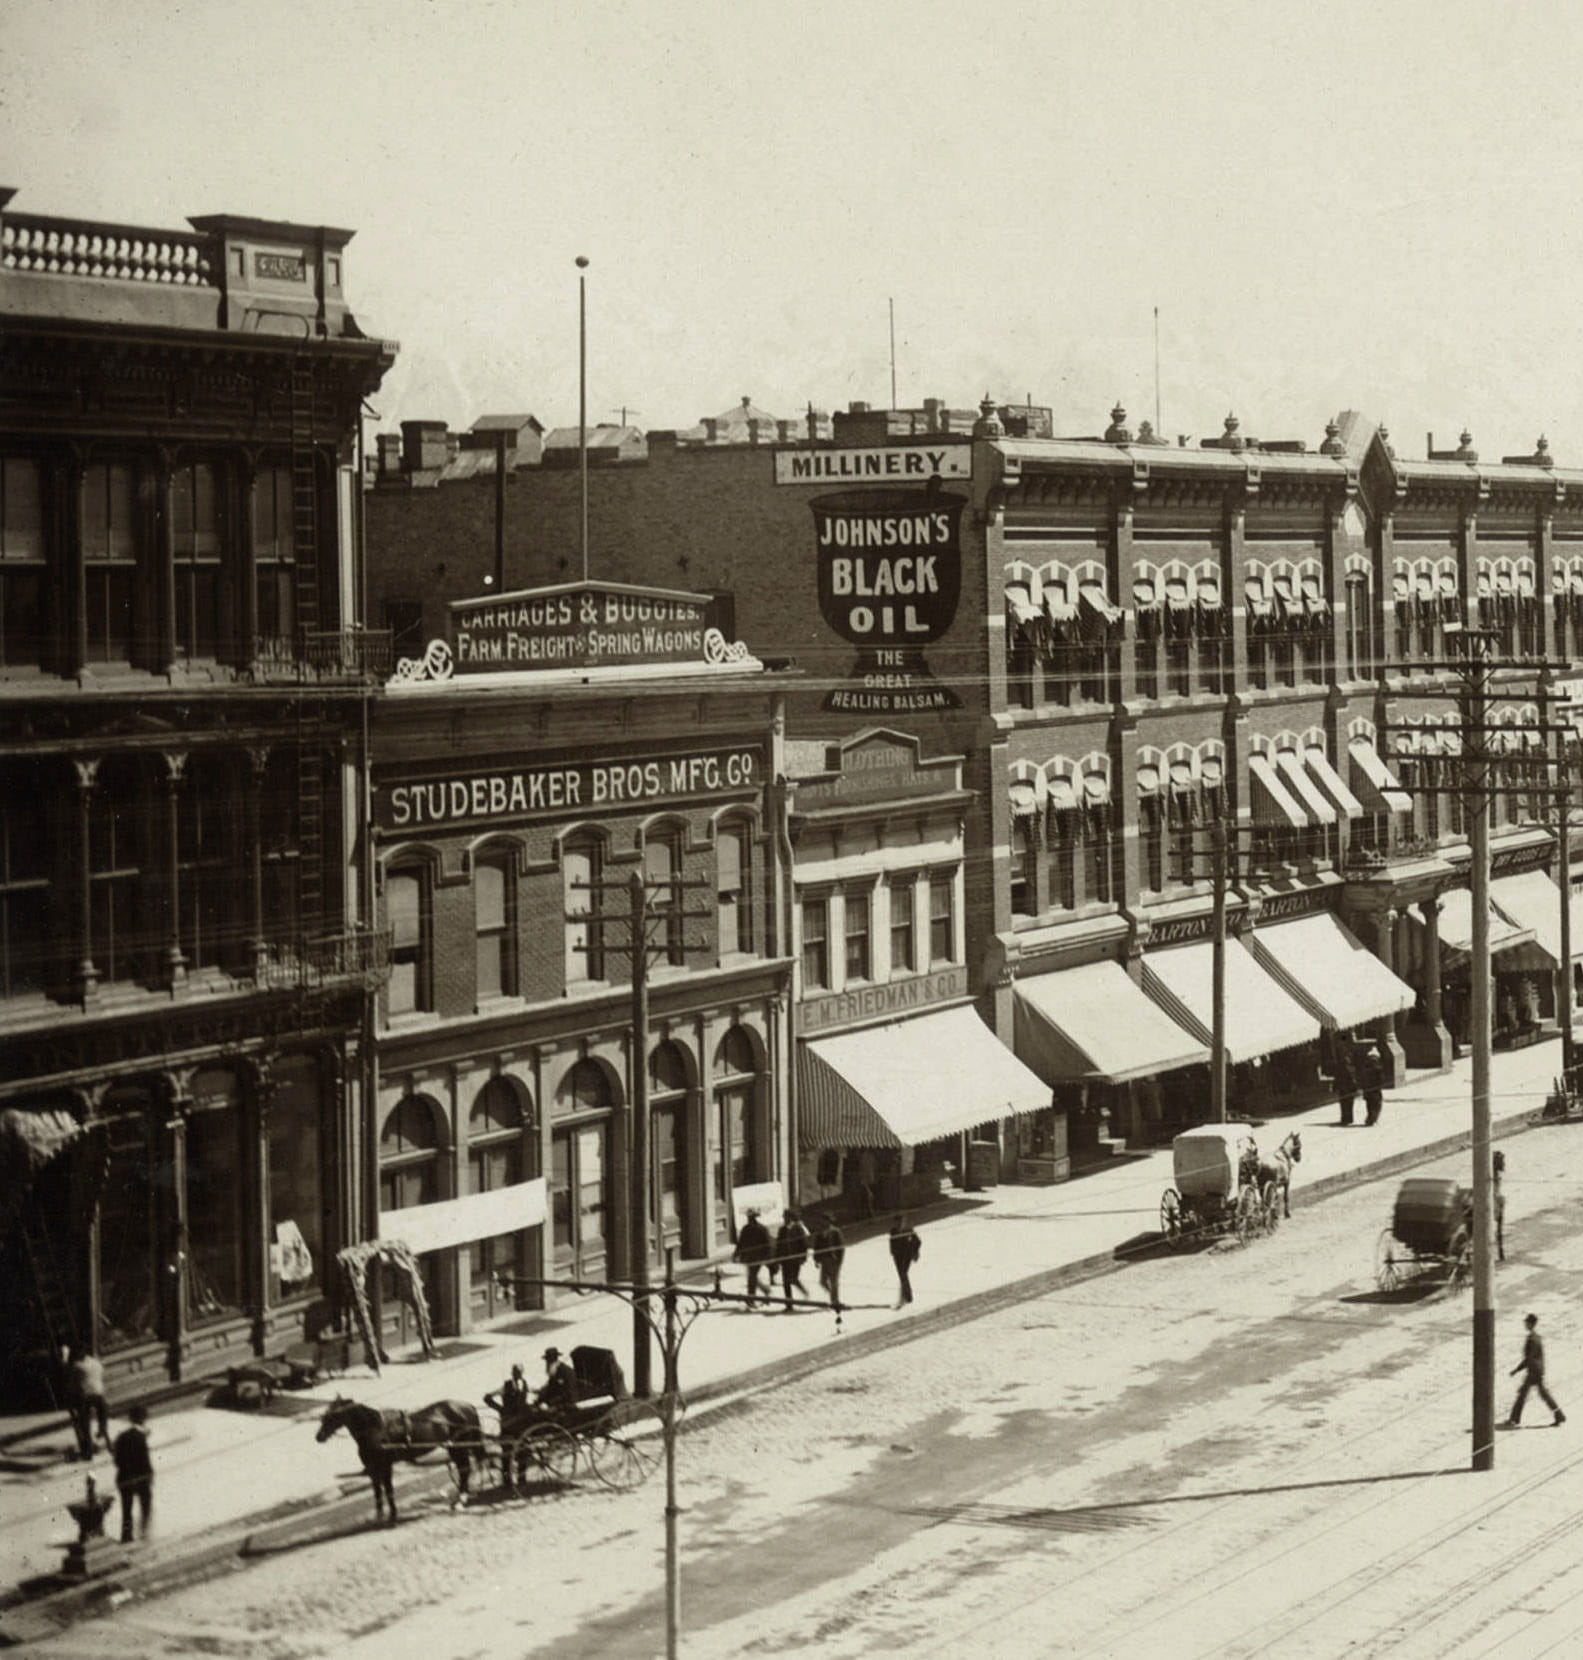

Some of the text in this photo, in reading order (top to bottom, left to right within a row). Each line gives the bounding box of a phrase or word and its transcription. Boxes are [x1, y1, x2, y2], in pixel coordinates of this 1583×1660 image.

[792, 452, 958, 477] MILLINERY.
[820, 513, 949, 546] JOHNSON'S
[832, 556, 939, 596] BLACK
[462, 598, 571, 628] CARRIAGES
[580, 594, 597, 624] &
[849, 605, 930, 633] OIL
[507, 632, 575, 660] FREIGHT
[588, 630, 640, 656] SPRING
[642, 627, 701, 653] WAGONS
[876, 650, 904, 665] THE
[864, 674, 911, 689] GREAT
[831, 691, 889, 709] HEALING
[391, 770, 581, 825] STUDEBAKER
[592, 762, 665, 803] BROS.
[1145, 917, 1207, 944] BARTON
[837, 981, 918, 1019] FRIEDMAN
[924, 979, 933, 1000] &
